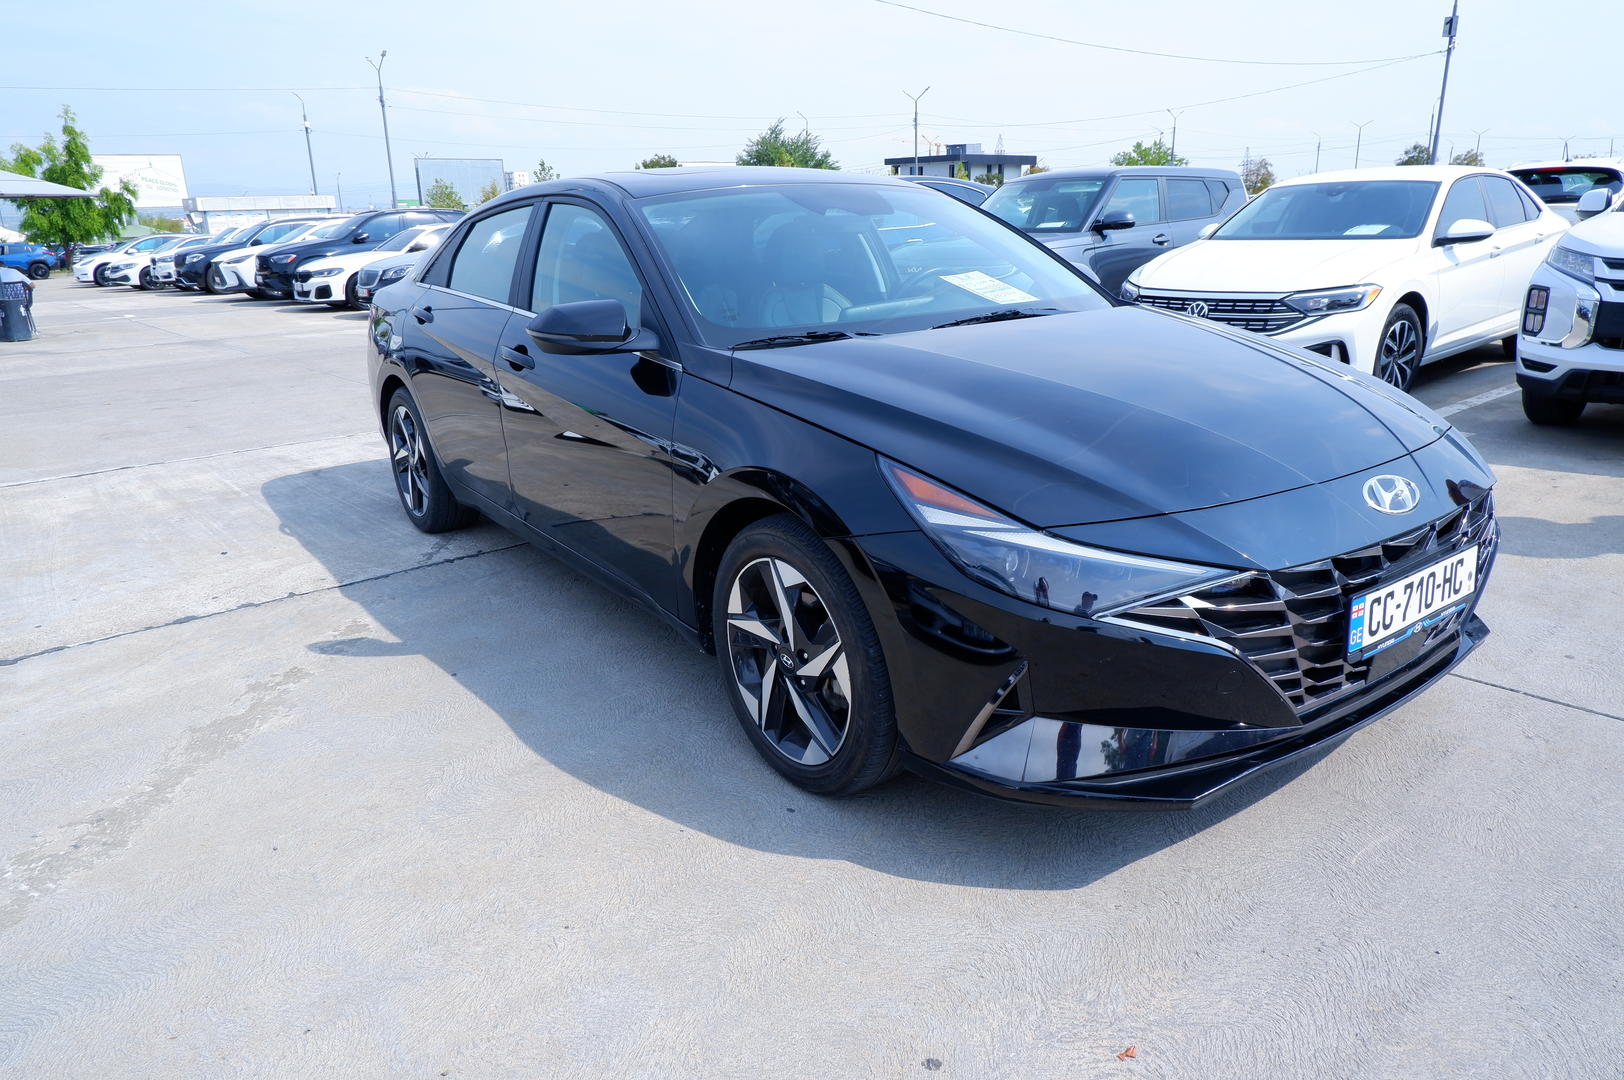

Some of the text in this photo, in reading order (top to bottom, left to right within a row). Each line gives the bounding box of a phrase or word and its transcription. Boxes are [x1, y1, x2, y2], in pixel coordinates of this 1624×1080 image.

[1446, 17, 1453, 35] 1
[1368, 558, 1464, 637] CC-710-HC
[1350, 626, 1363, 645] GE
